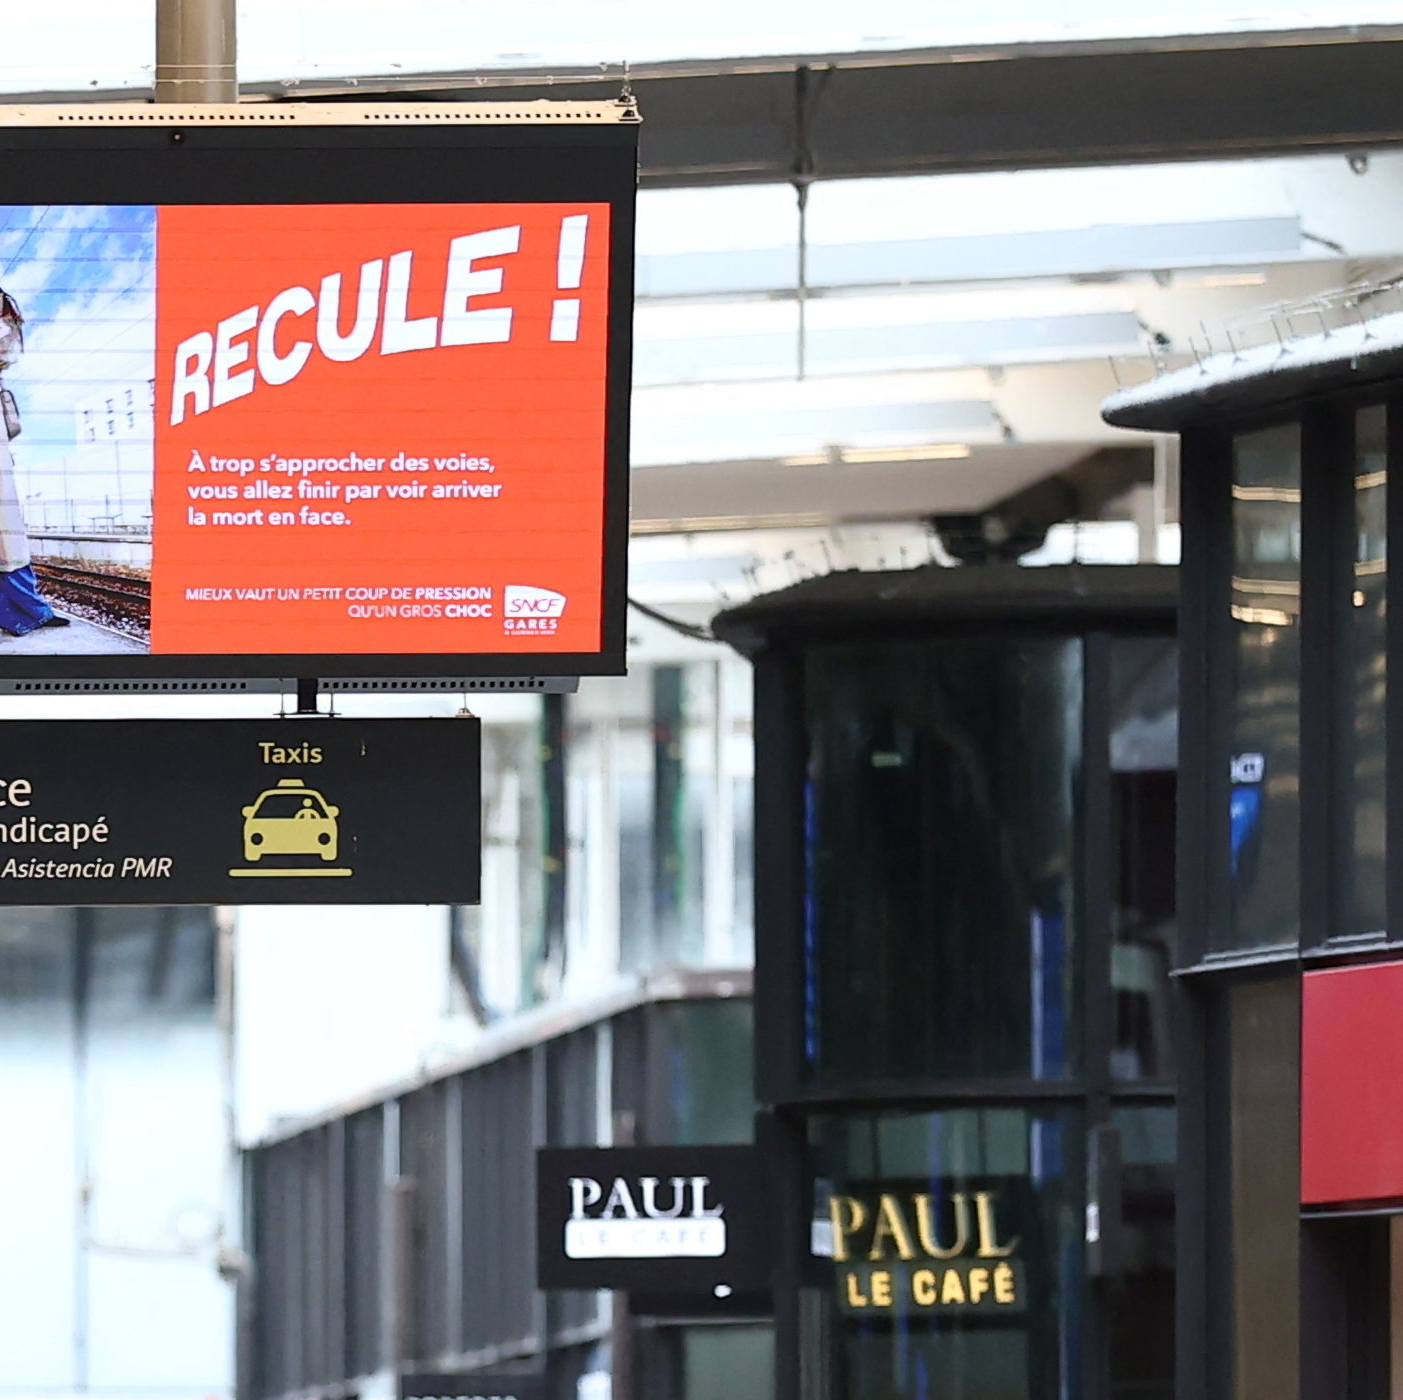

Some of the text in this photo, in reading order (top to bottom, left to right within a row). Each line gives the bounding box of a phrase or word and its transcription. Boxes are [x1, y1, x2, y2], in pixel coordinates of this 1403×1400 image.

[170, 225, 520, 426] RECULE
[188, 450, 206, 471] À
[209, 456, 255, 476] trop
[390, 452, 429, 471] des
[433, 453, 495, 472] voies,
[188, 479, 502, 503] vous allez finir par voir arriver
[188, 506, 351, 525] la mort en face.
[186, 587, 491, 600] MIEUX VAUT UN PETIT COUP DE PRESSION
[399, 604, 442, 617] GROS
[445, 604, 492, 617] CHOC
[509, 598, 561, 613] SNCF
[504, 619, 557, 629] GARES
[259, 743, 322, 763] Taxis
[1, 858, 114, 877] Asistencia
[121, 858, 172, 877] PMR
[570, 1177, 722, 1220] PAUL
[830, 1191, 1021, 1261] PAUL
[848, 1262, 1014, 1306] LE CAFÉ
